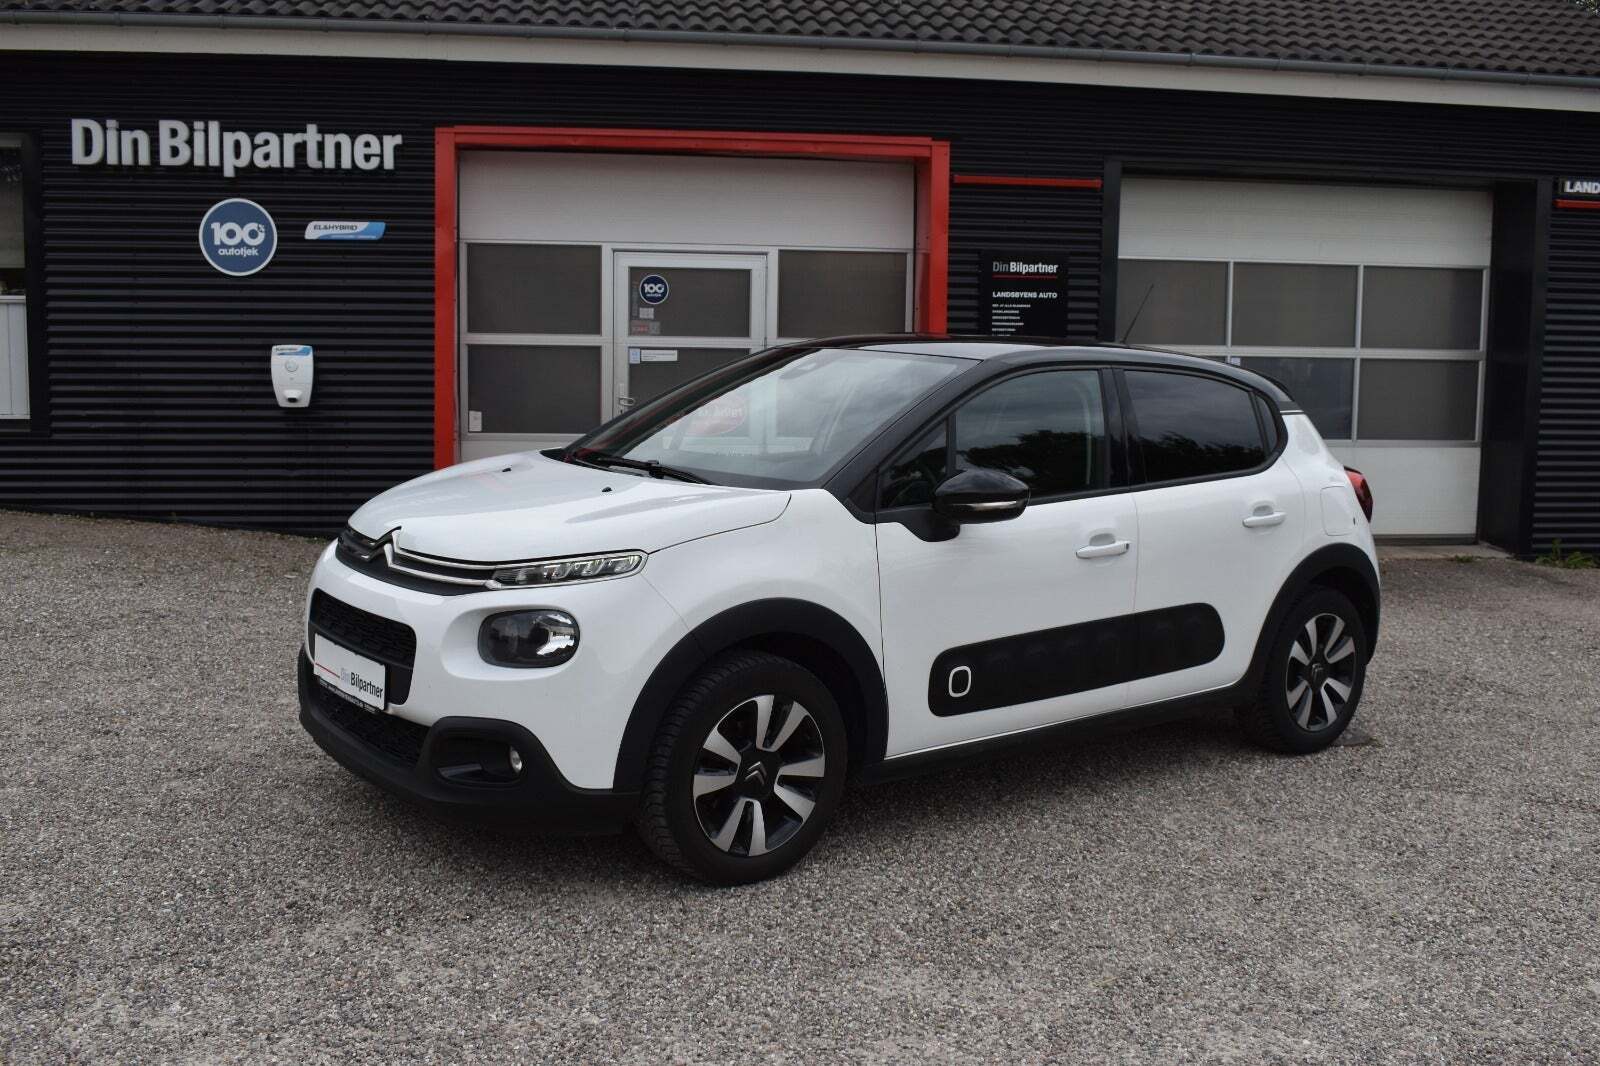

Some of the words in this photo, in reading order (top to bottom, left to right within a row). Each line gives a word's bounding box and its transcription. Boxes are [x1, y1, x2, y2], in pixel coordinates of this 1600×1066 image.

[71, 118, 150, 166] Din
[158, 120, 402, 178] Bilpartner
[218, 246, 259, 258] autotjek
[992, 261, 1009, 272] Din
[1010, 261, 1058, 274] Bilpartner
[351, 672, 383, 698] Bilpartner
